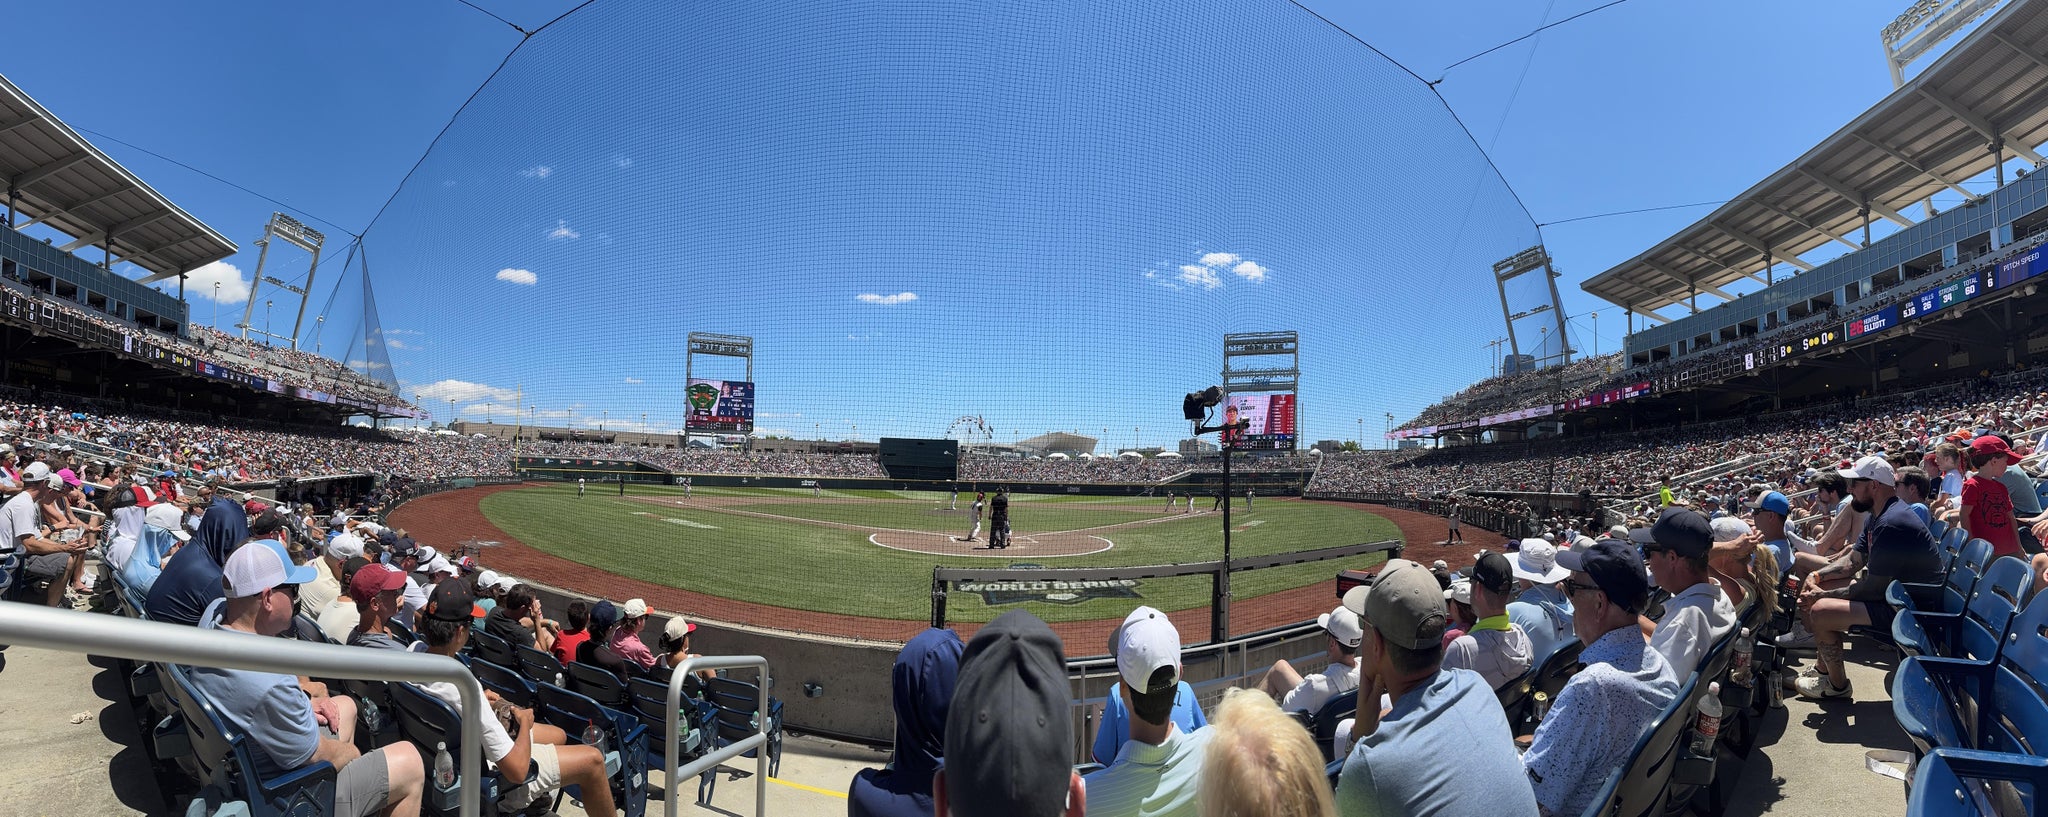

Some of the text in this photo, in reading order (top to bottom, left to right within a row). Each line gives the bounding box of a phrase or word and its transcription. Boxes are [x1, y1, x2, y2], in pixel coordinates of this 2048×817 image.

[2032, 234, 2044, 243] 209
[2003, 252, 2040, 271] PITCH SPEED
[1963, 277, 1978, 286] TOTAL
[1987, 278, 1993, 287] 6
[1938, 284, 1958, 296] STRIKES
[1965, 285, 1975, 295] 60
[1921, 293, 1934, 303] BALLS
[1943, 293, 1952, 303] 34
[1923, 301, 1931, 311] 26
[1864, 315, 1879, 324] HUNTER
[1849, 318, 1886, 336] 26 ELLIOTT
[1802, 338, 1808, 350] S
[156, 348, 160, 359] B
[1780, 346, 1786, 357] B
[172, 354, 176, 364] S
[960, 581, 1047, 592] WORLD
